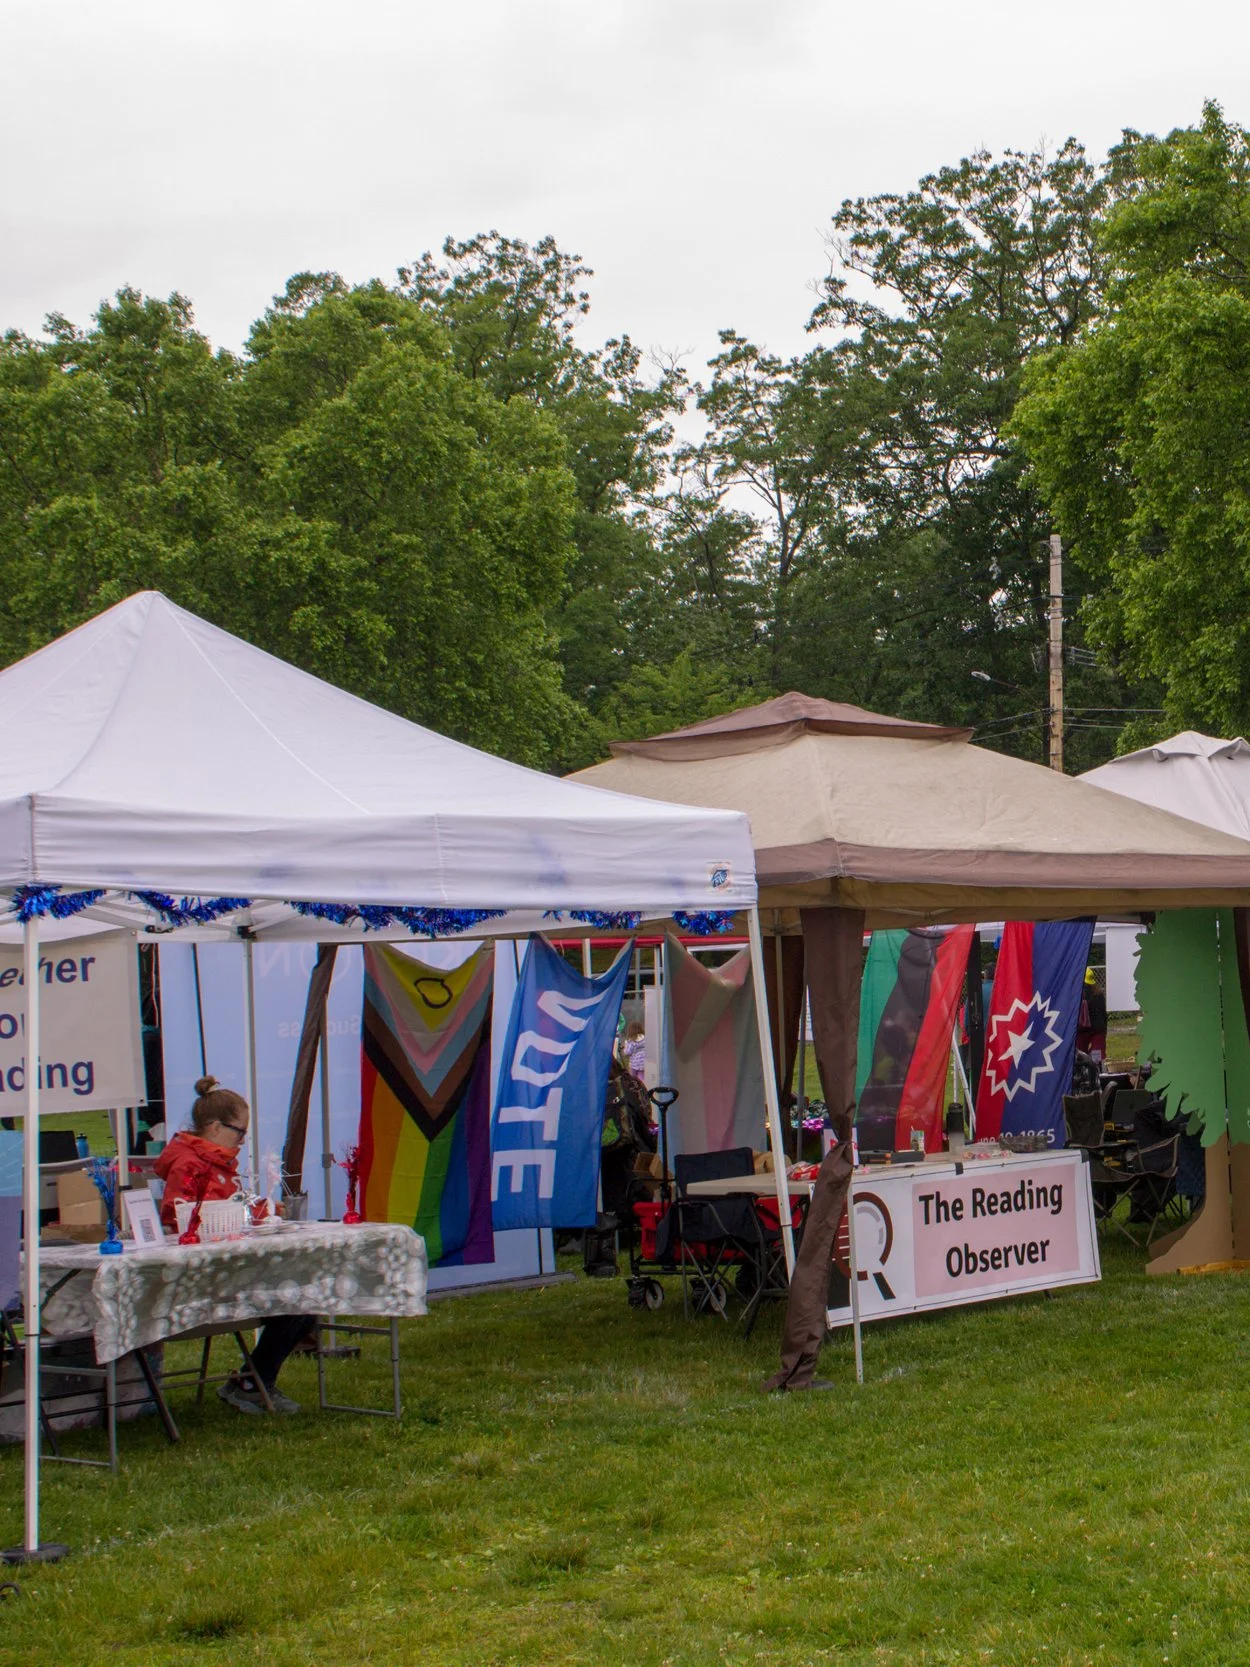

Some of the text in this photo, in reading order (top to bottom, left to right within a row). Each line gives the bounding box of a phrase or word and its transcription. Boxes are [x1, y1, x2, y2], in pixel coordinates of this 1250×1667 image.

[491, 986, 610, 1202] VOTE
[919, 1179, 1063, 1226] The Reading
[946, 1239, 1051, 1278] Observer
